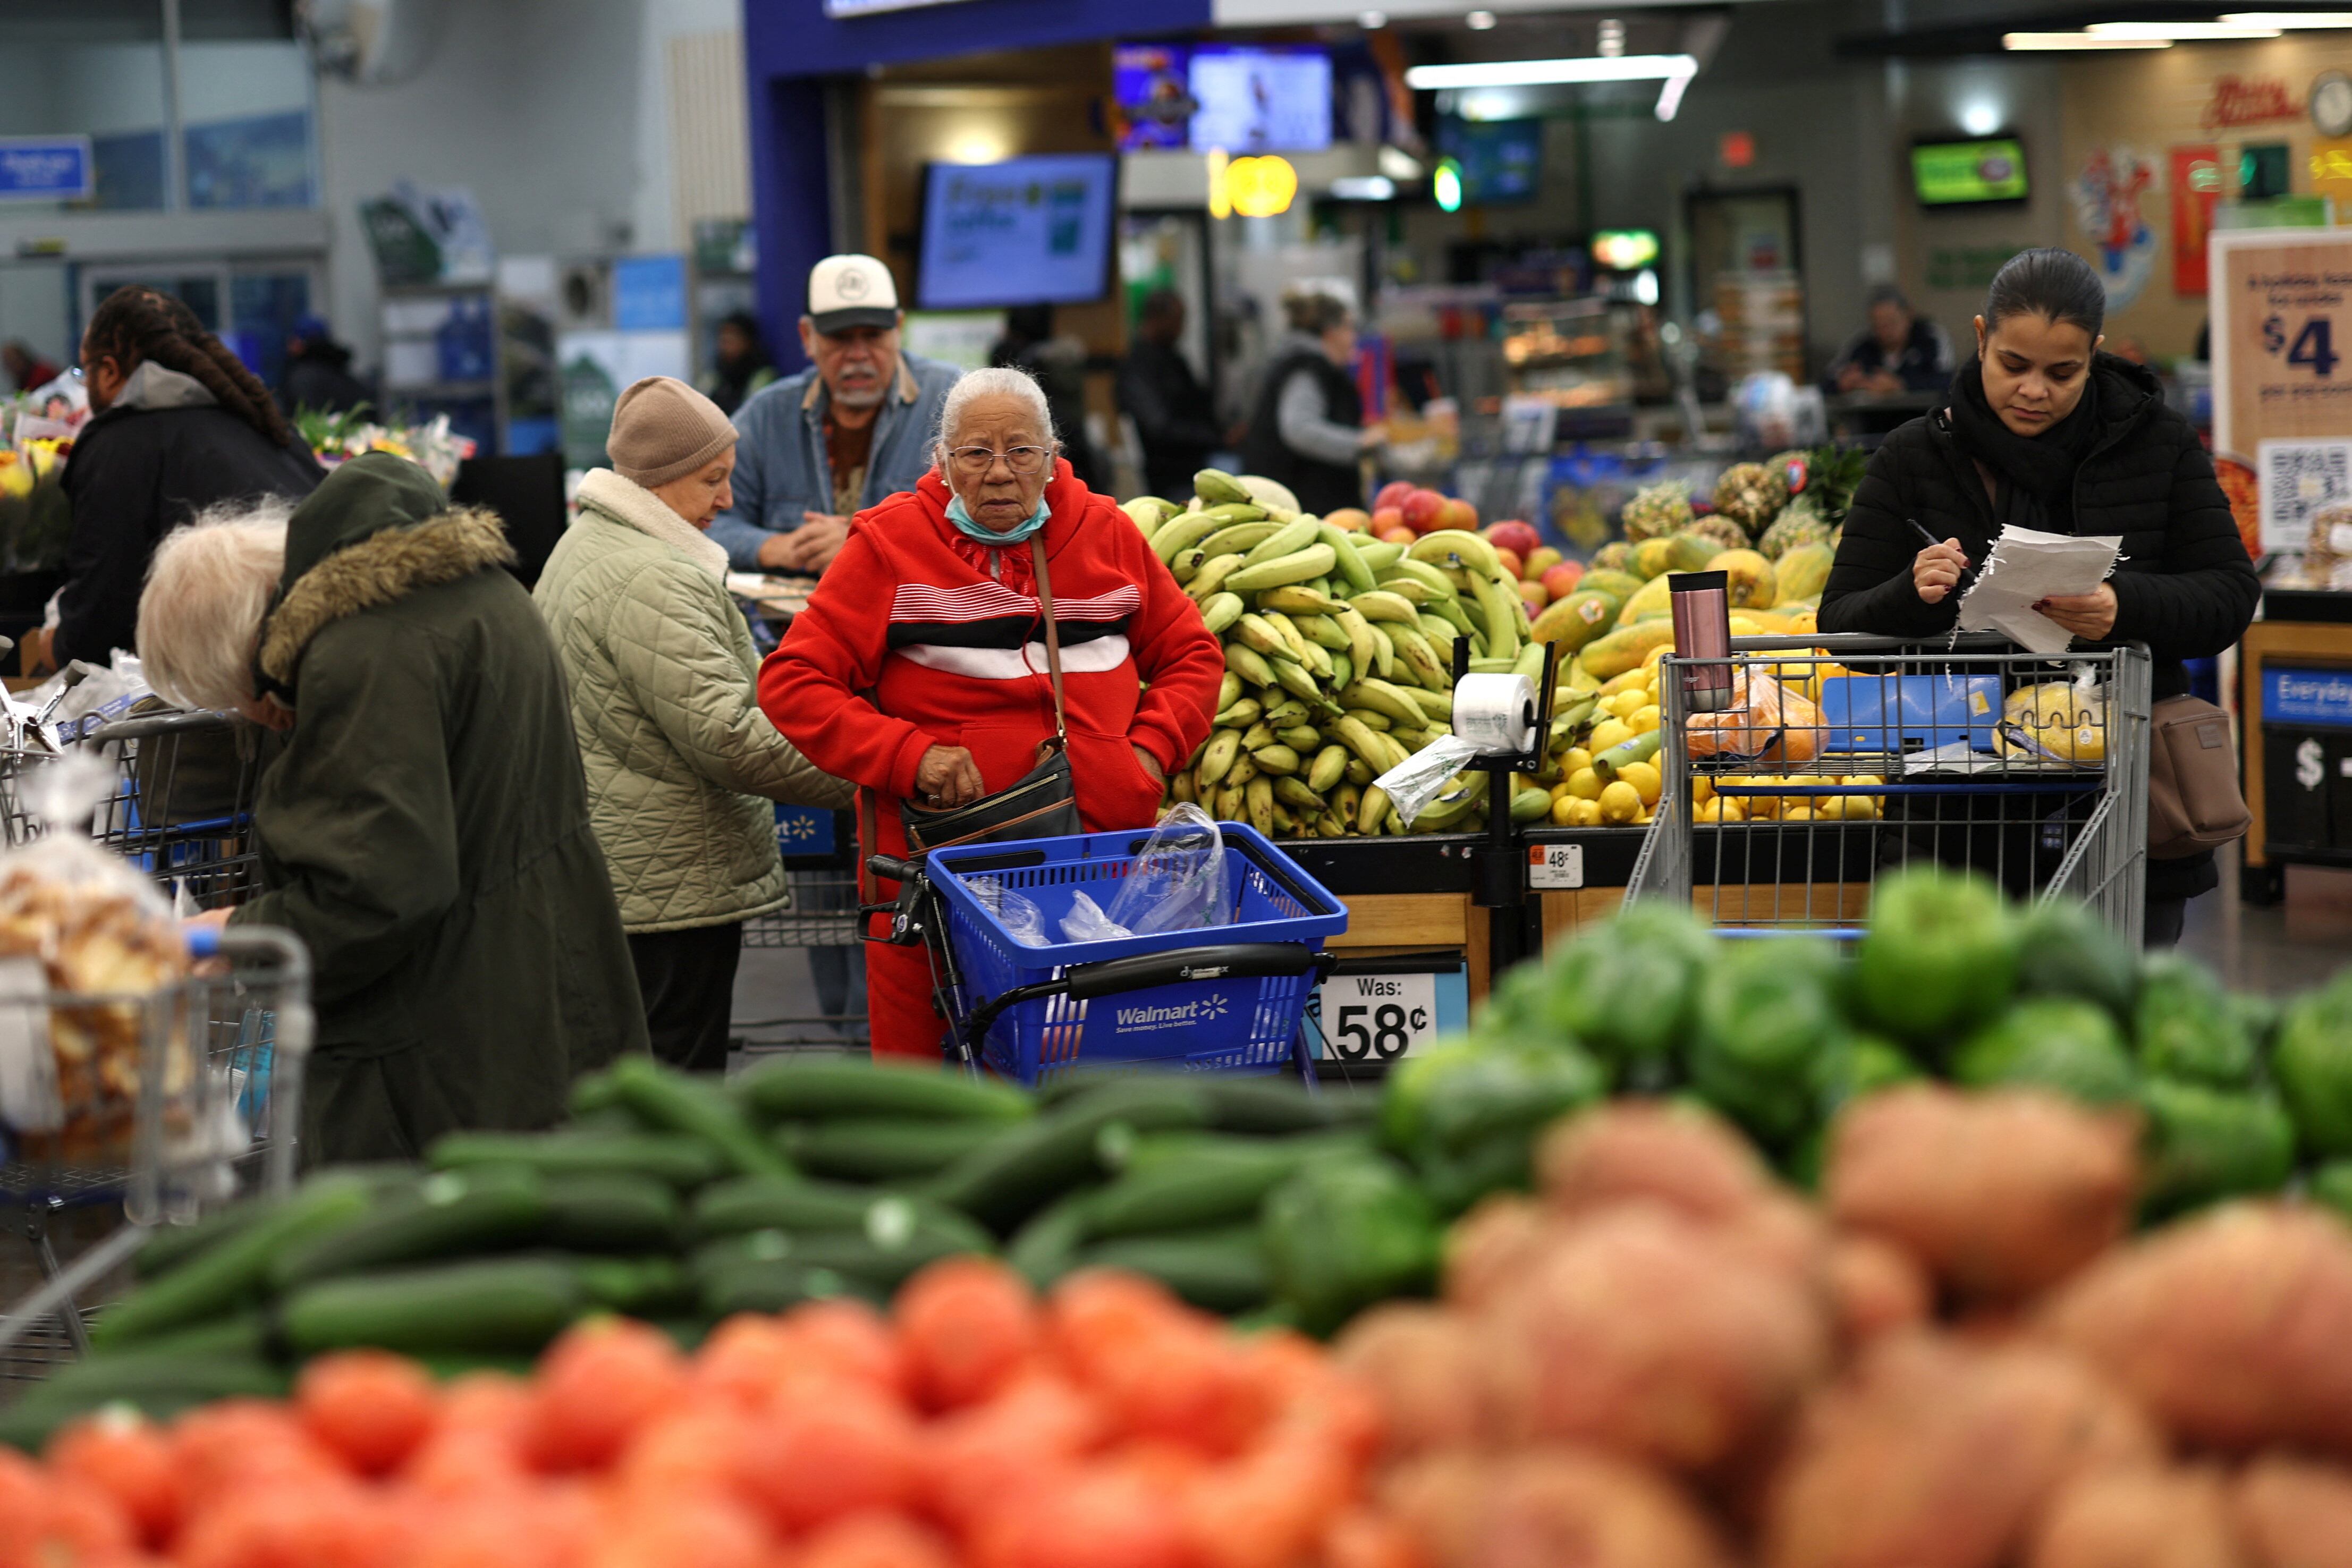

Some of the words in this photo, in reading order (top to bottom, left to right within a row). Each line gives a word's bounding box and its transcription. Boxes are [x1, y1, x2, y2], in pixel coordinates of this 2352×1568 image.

[2263, 313, 2340, 378] $4
[1357, 978, 1401, 996] Was:
[1117, 1001, 1199, 1025] Walmart
[1336, 1003, 1427, 1060] 58¢
